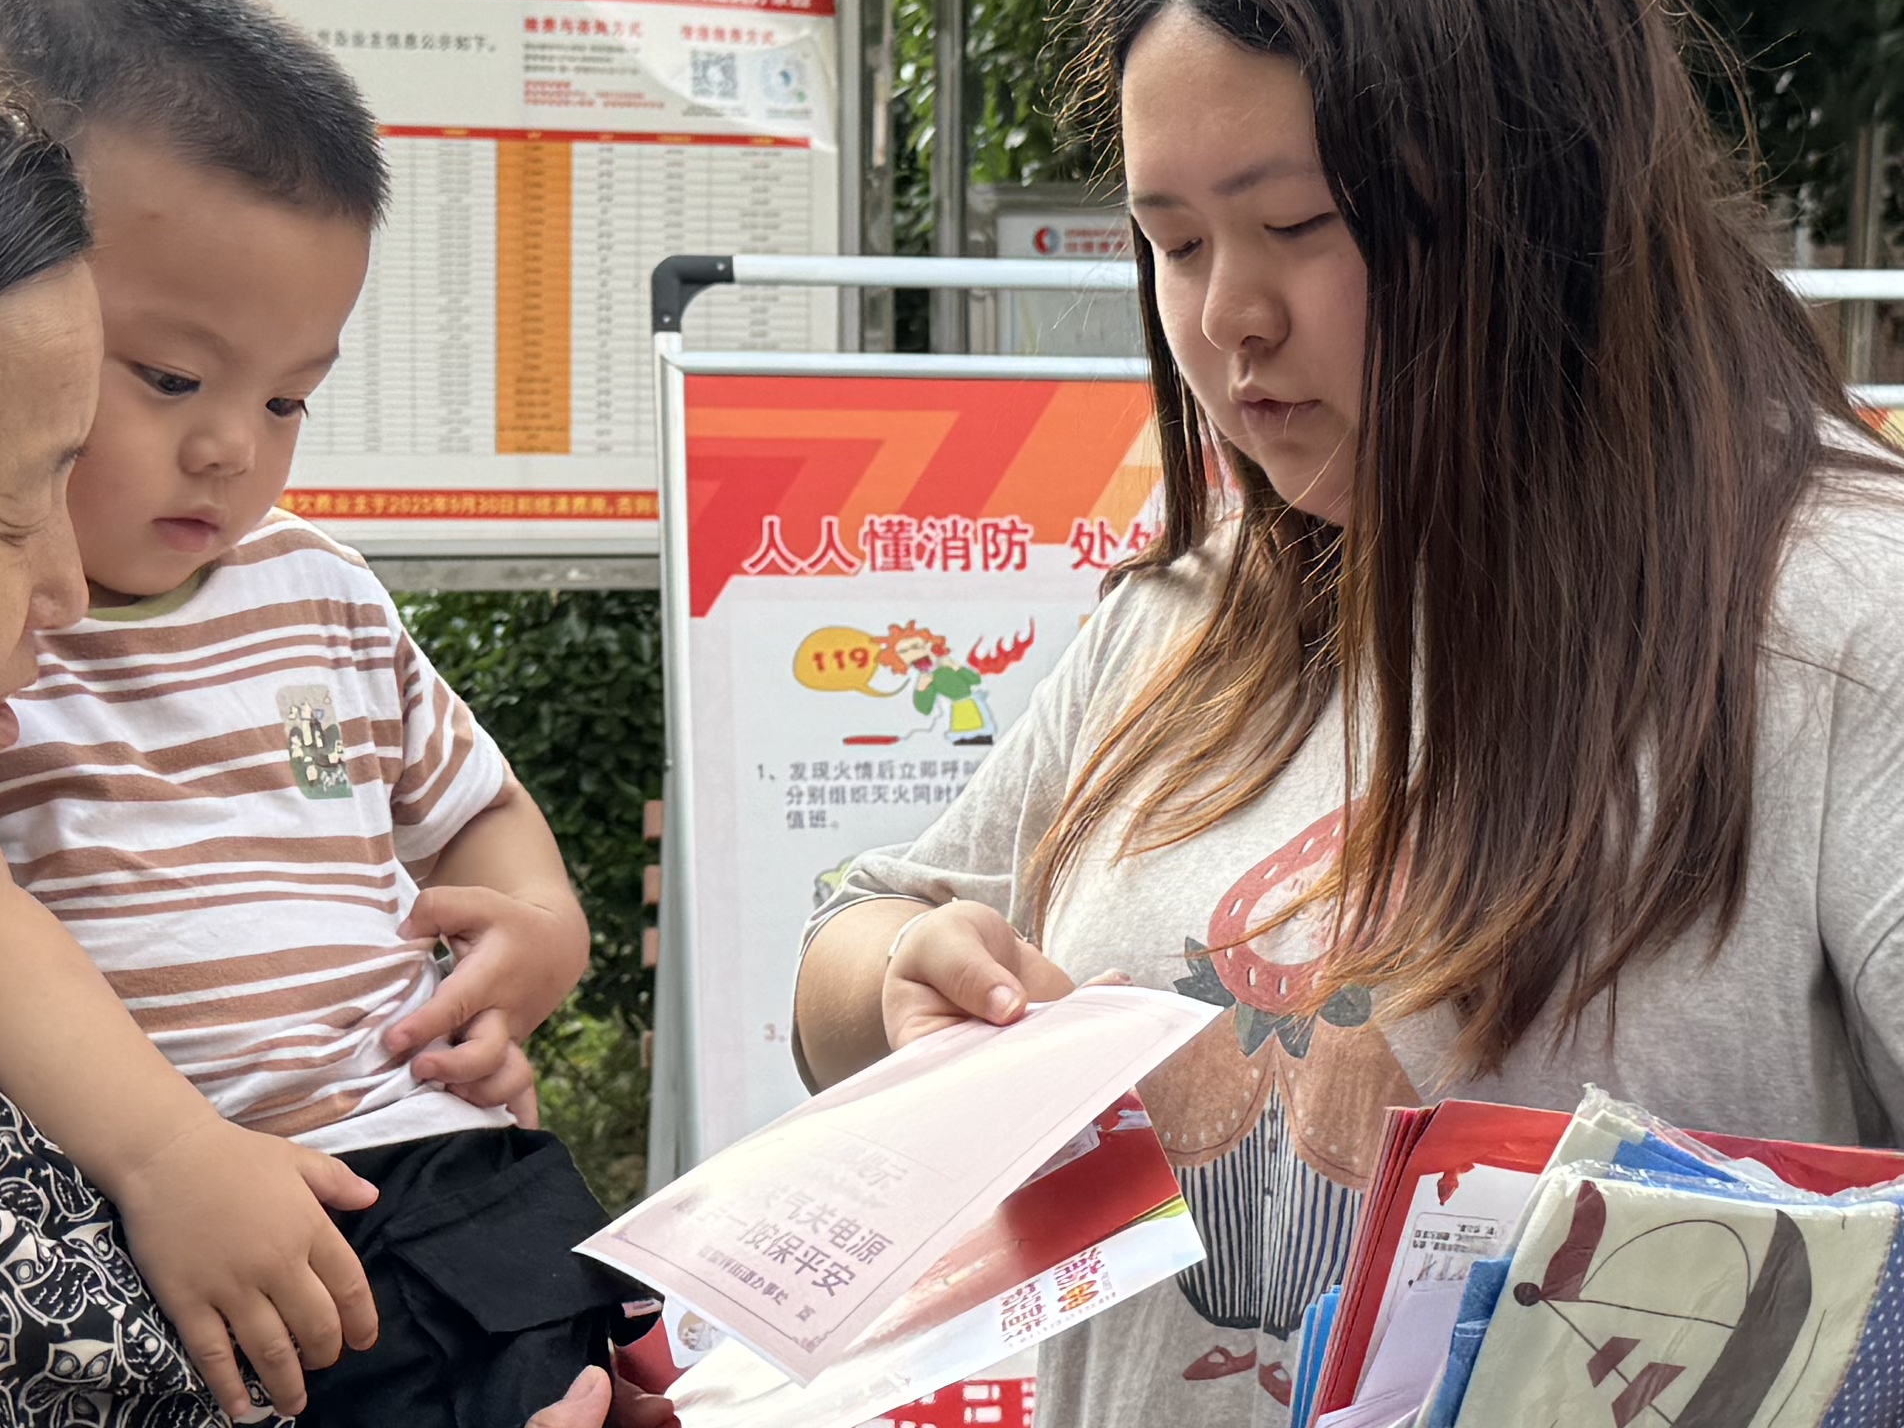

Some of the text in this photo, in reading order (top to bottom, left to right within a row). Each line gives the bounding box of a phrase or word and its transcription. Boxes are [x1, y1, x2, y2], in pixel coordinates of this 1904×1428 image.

[743, 514, 1033, 575] 人人懂消防
[812, 646, 870, 672] 119
